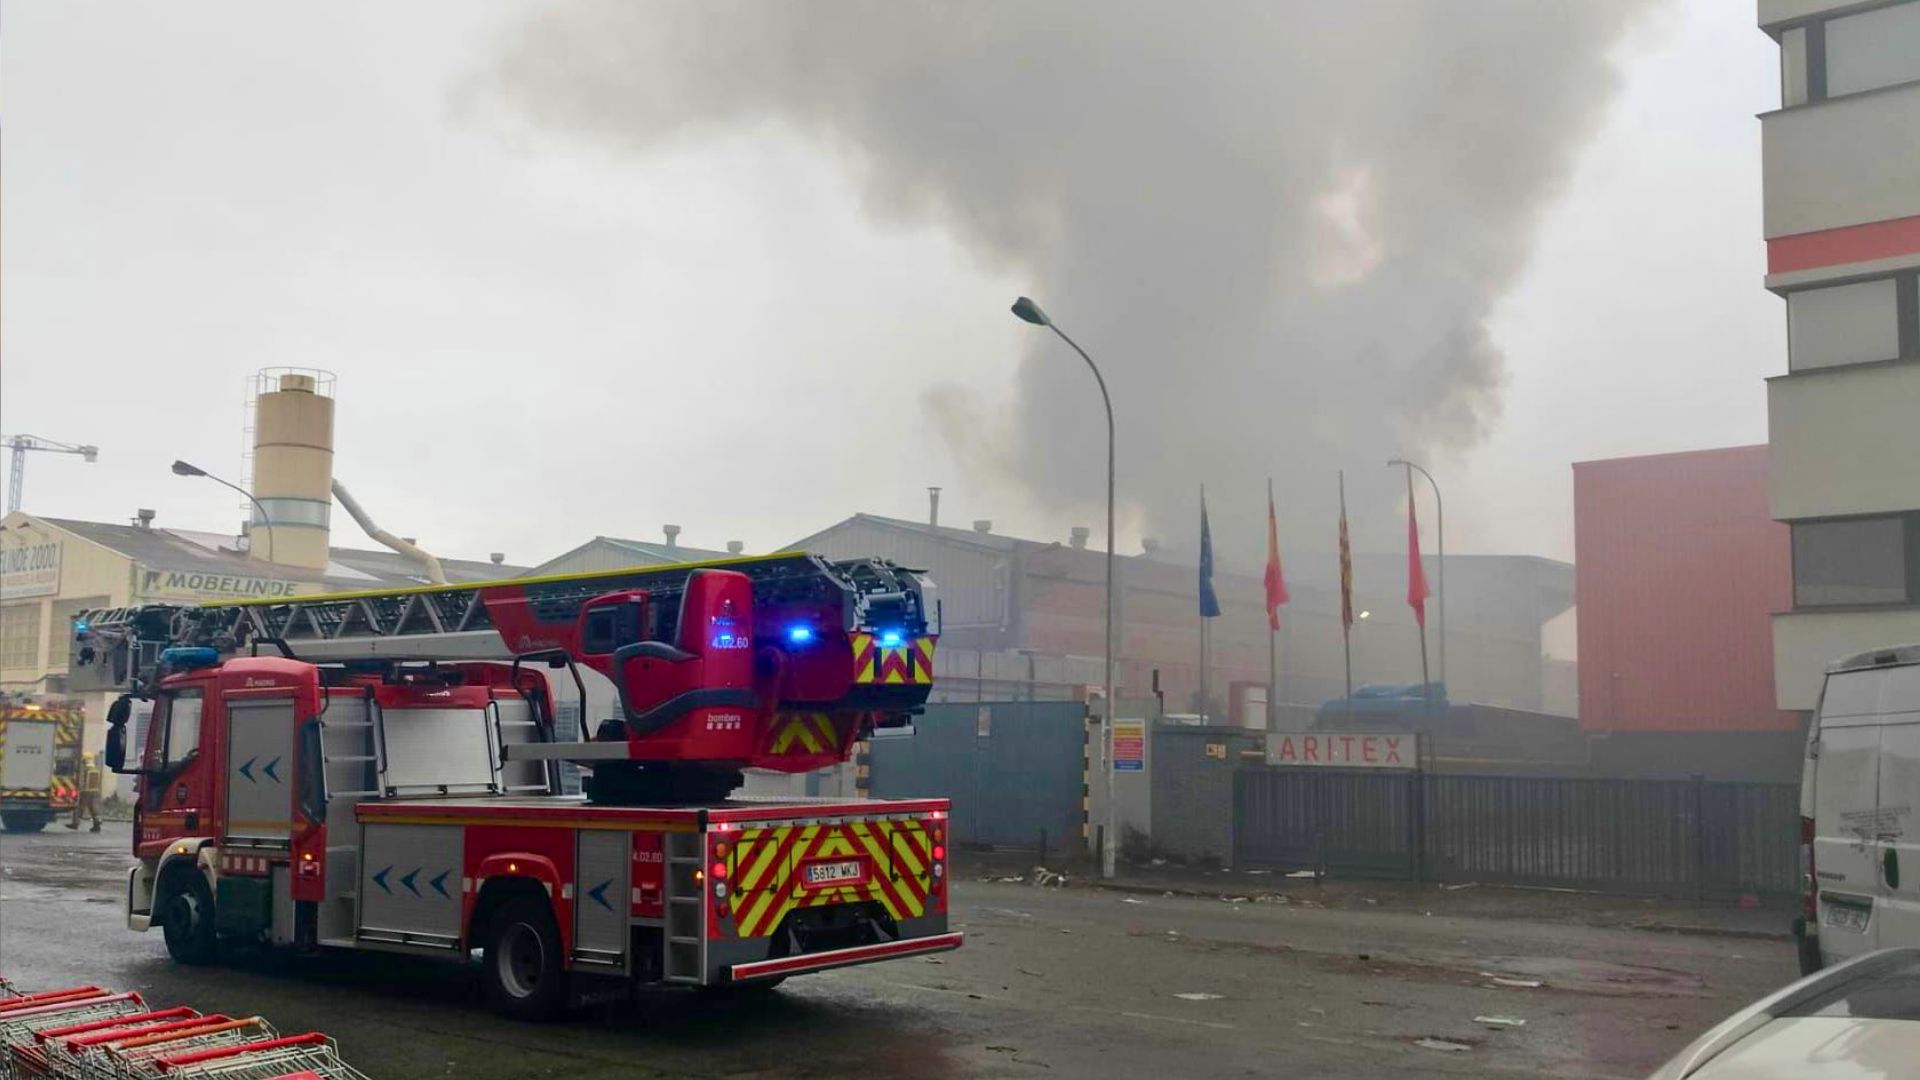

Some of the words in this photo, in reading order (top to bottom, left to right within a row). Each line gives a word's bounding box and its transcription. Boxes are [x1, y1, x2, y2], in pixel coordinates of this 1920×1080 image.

[166, 573, 297, 596] MOBELINDE
[1280, 736, 1400, 763] ARITEX
[814, 867, 836, 880] 5812
